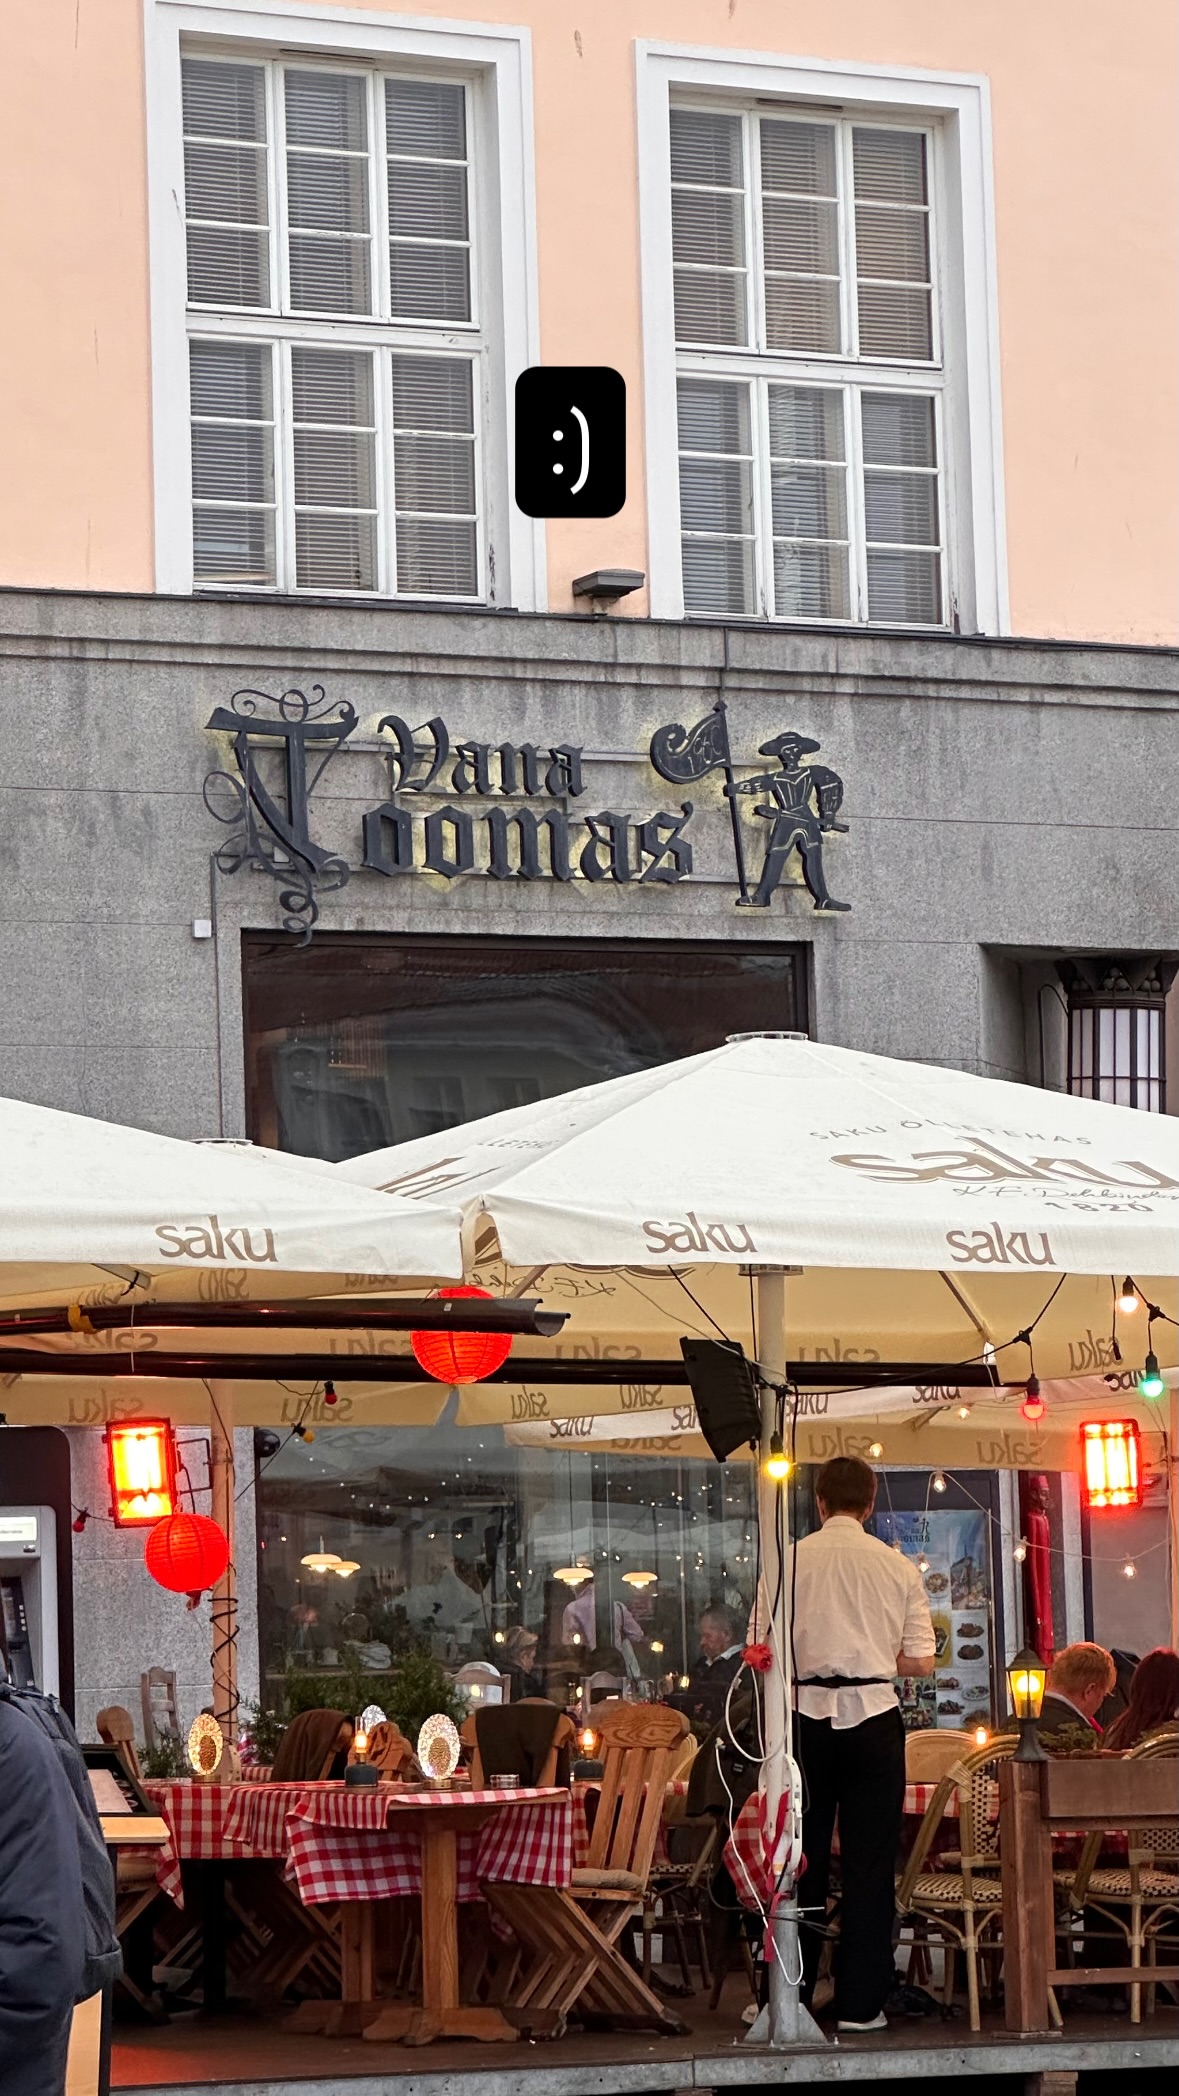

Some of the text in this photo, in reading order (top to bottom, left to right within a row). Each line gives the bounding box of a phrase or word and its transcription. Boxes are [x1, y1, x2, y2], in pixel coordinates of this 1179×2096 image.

[376, 714, 588, 797] Vana
[203, 688, 694, 915] Toomas
[809, 1125, 888, 1141] SAKU
[828, 1136, 1179, 1191] saku
[1043, 1202, 1155, 1213] 1820
[155, 1215, 279, 1263] saku
[641, 1211, 758, 1254] saku
[945, 1221, 1057, 1266] saku
